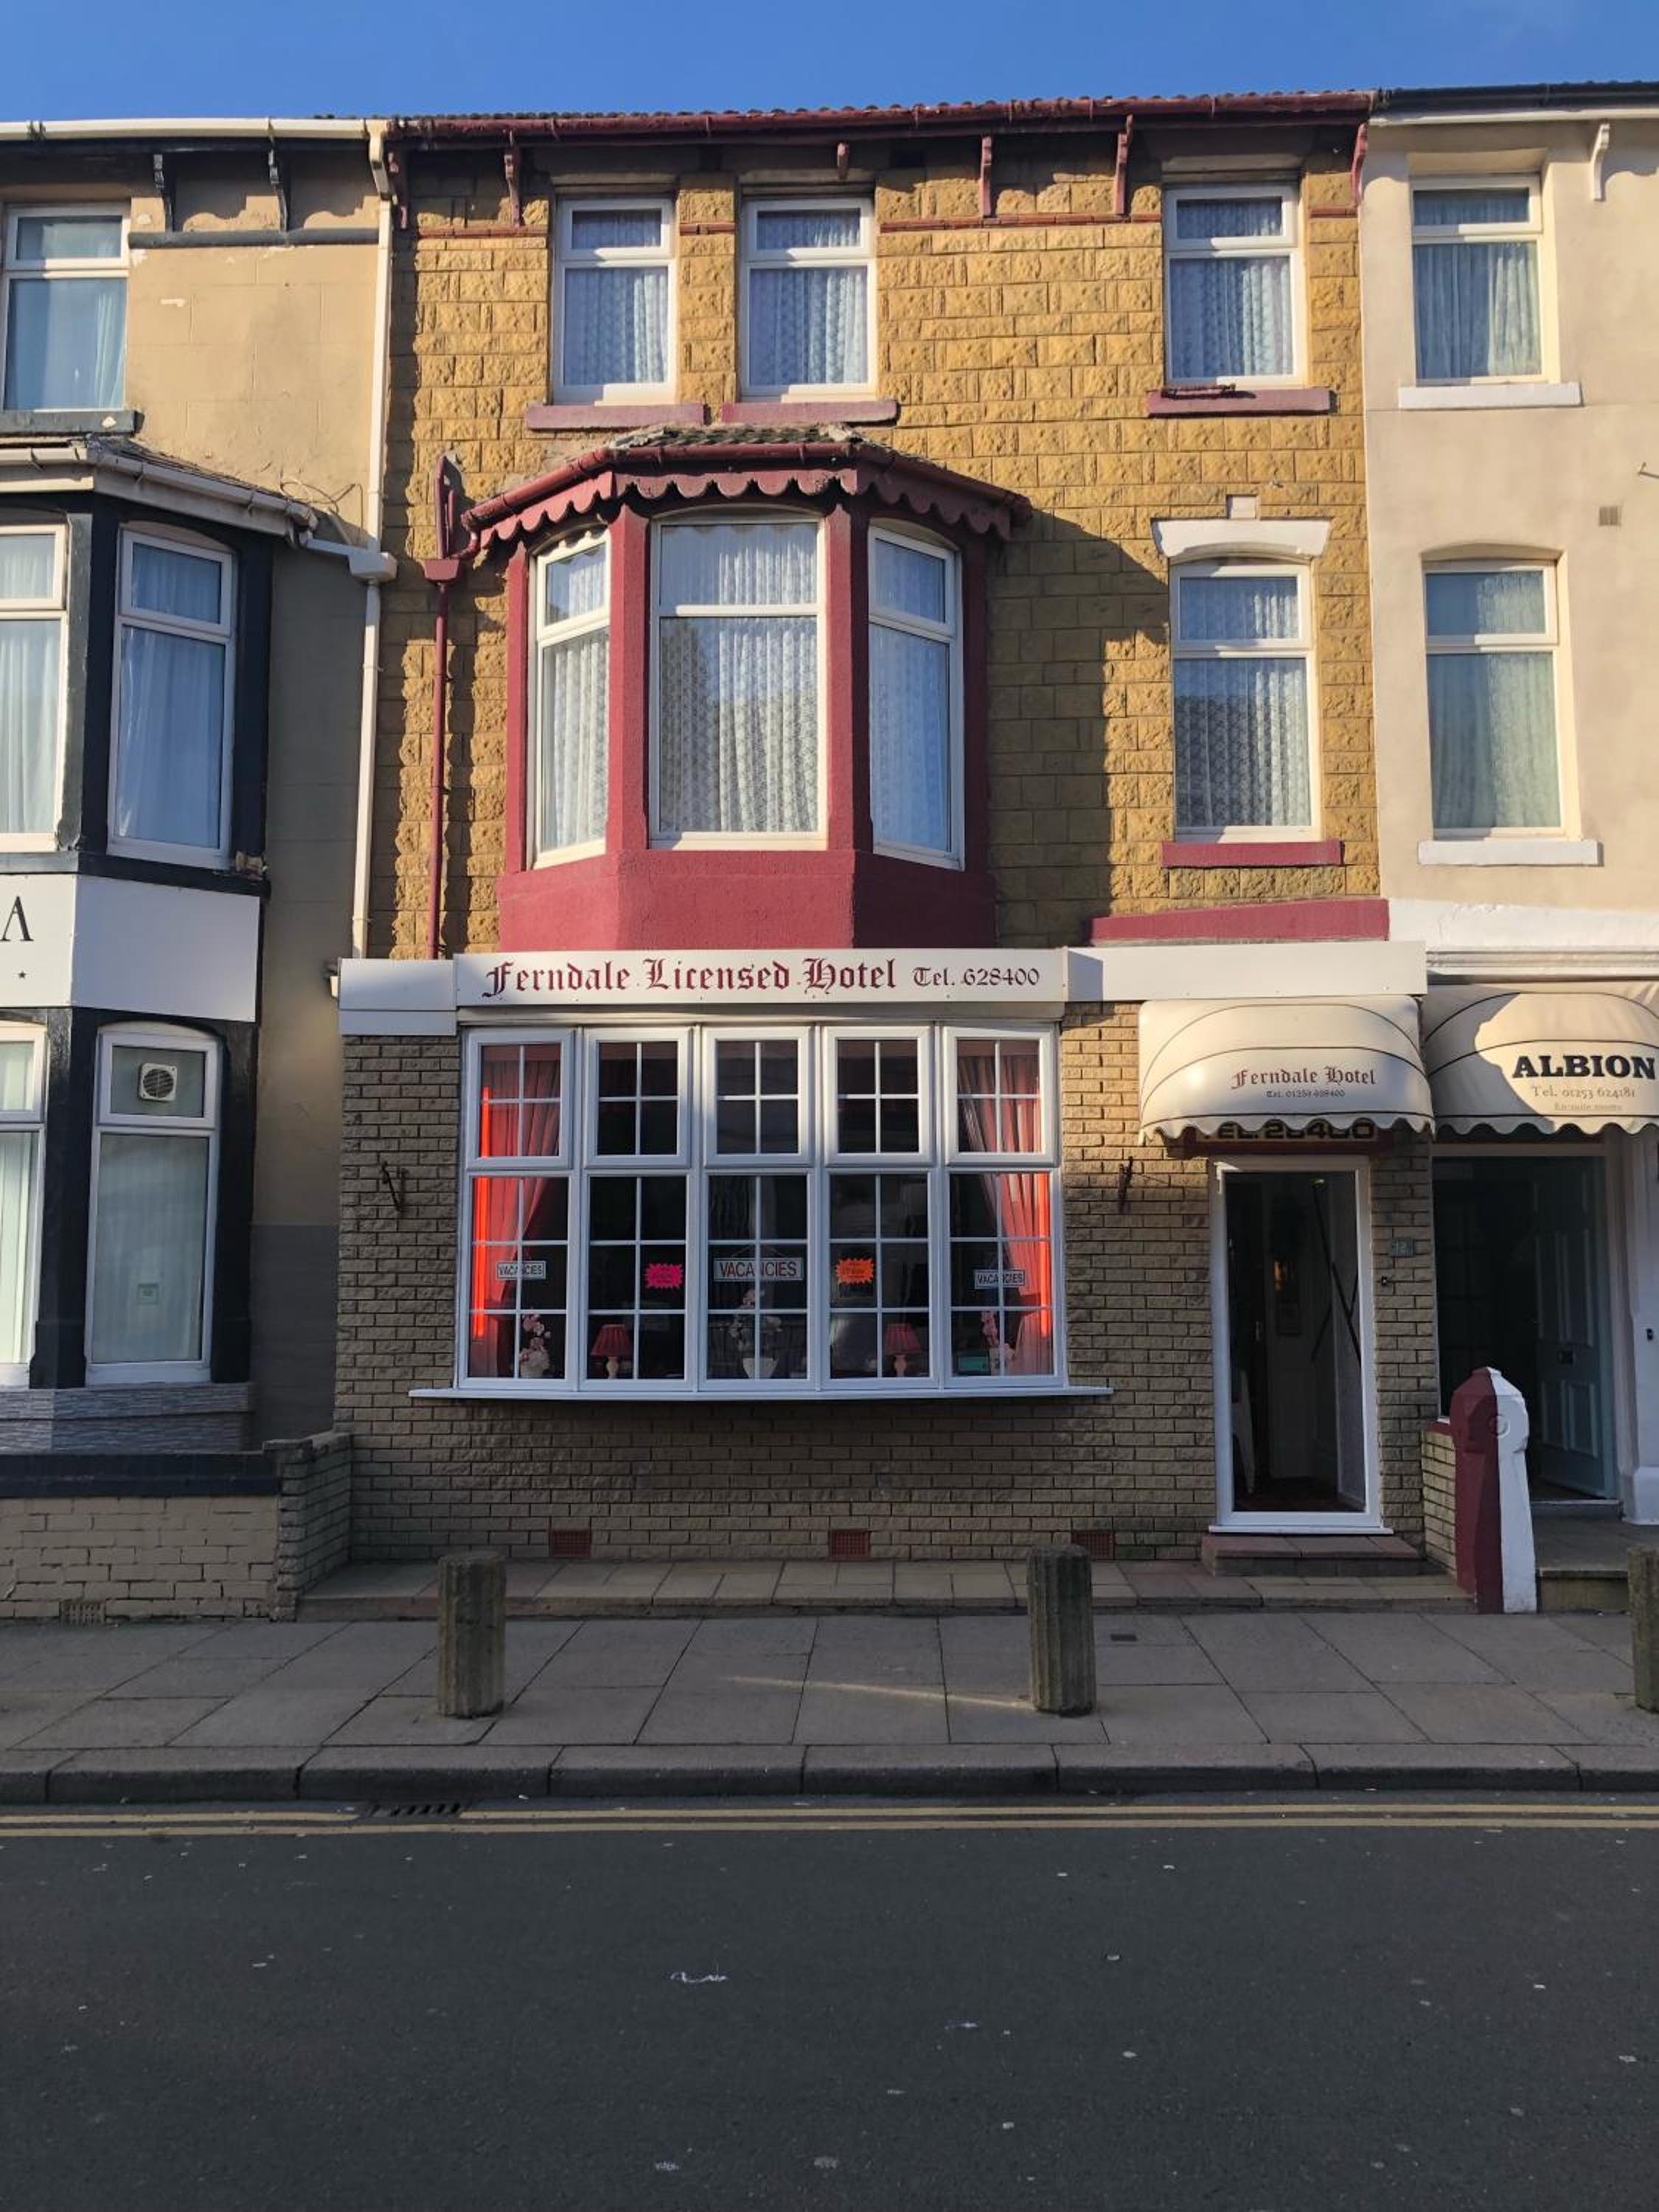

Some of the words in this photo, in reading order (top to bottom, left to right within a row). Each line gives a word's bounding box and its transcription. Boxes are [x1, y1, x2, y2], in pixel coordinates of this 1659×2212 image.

[0, 896, 34, 942] A
[482, 961, 630, 997] Ferndale
[643, 958, 790, 990] Licensed
[802, 958, 897, 994] Hotel
[911, 967, 956, 987] Tel.
[963, 967, 1040, 987] 628400
[1231, 1068, 1318, 1090] Ferndale
[1324, 1065, 1377, 1085] Hotel
[1512, 1055, 1656, 1079] ALBION
[1531, 1085, 1558, 1098] Tel.
[1562, 1088, 1593, 1099] 01253
[1597, 1085, 1635, 1099] 624181
